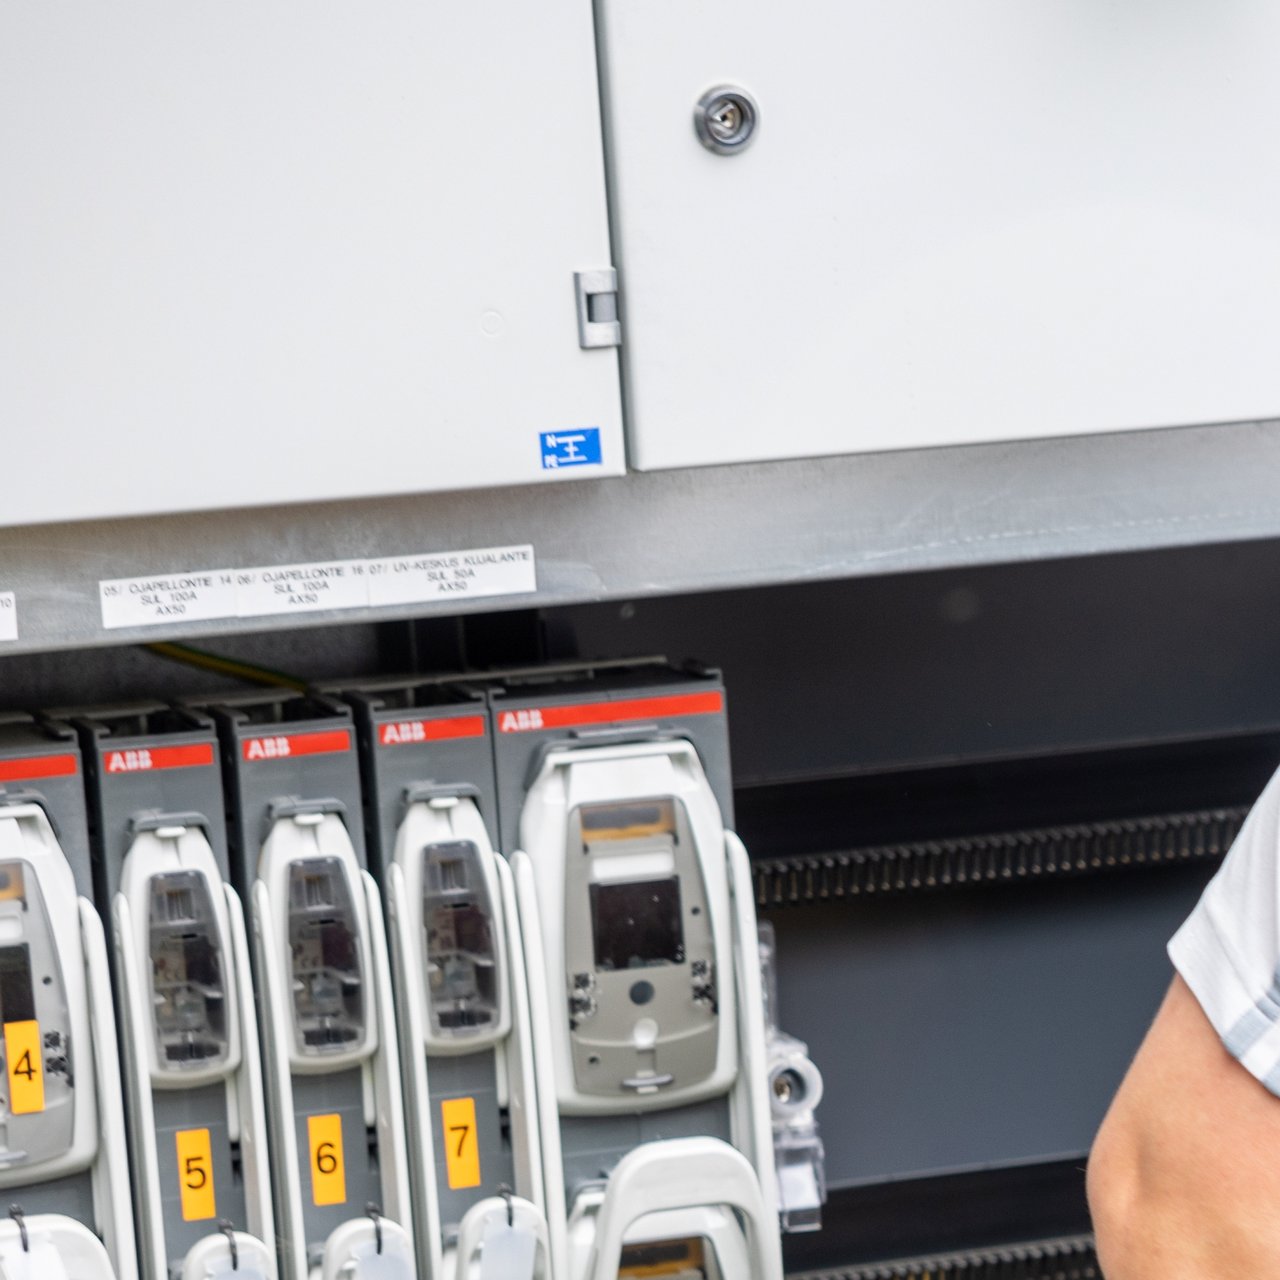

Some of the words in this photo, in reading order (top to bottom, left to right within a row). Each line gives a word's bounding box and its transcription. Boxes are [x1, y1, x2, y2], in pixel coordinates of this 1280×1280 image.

[383, 722, 426, 744] ABB
[502, 708, 544, 732] ABB
[109, 750, 153, 773] ABB
[248, 737, 291, 760] ABB
[13, 1048, 37, 1081] 4
[450, 1125, 470, 1158] 7
[315, 1142, 337, 1174] 6
[185, 1156, 207, 1190] 5
